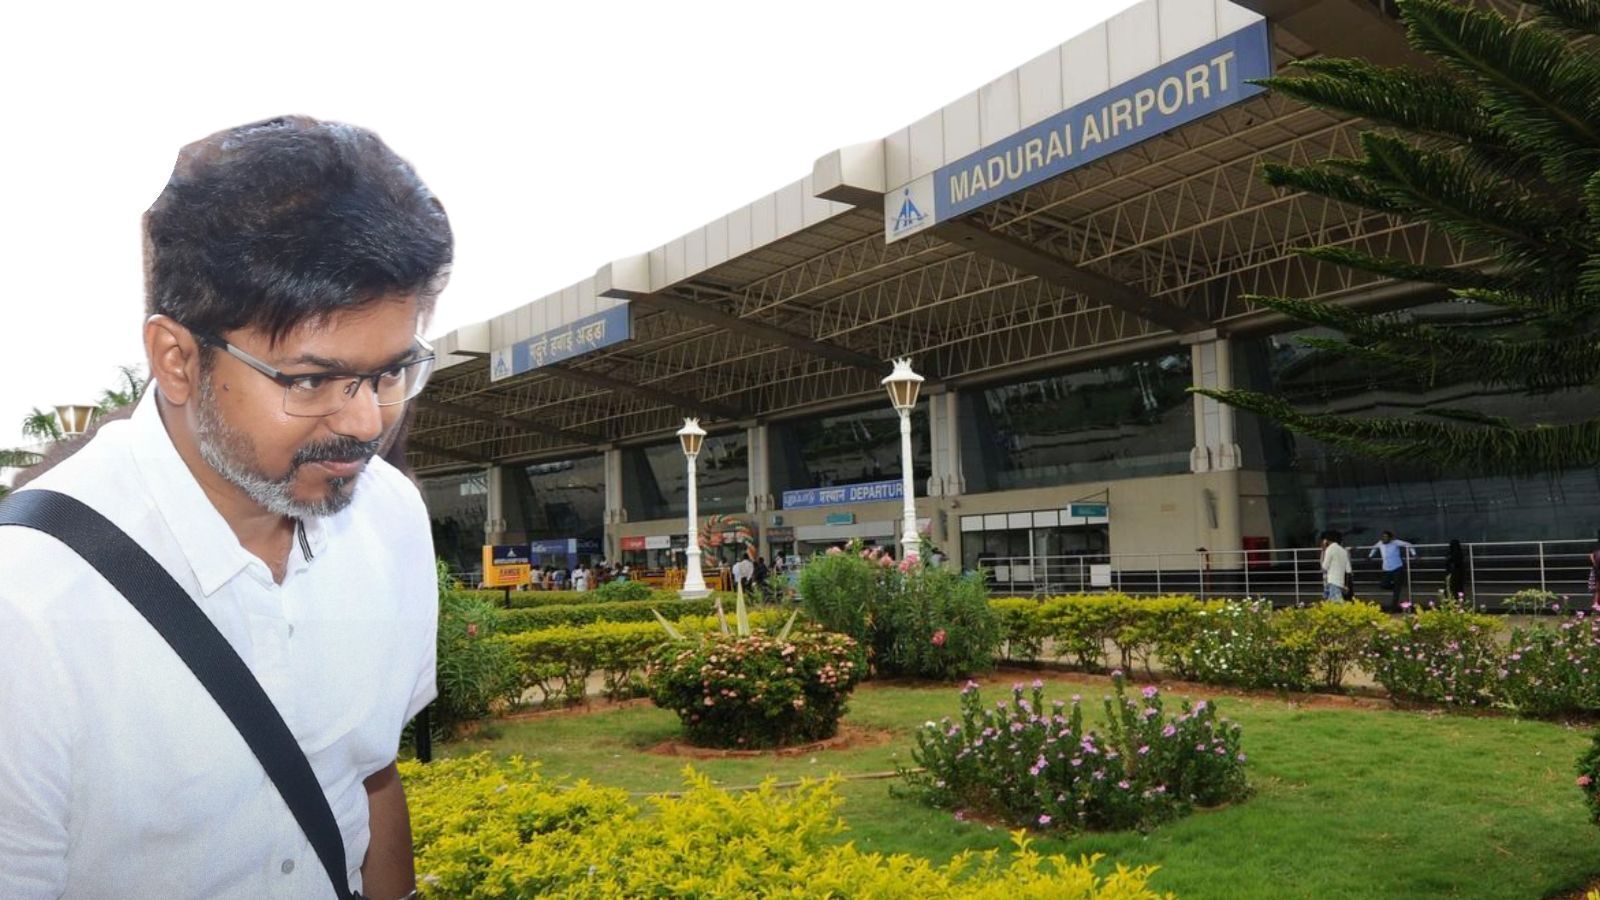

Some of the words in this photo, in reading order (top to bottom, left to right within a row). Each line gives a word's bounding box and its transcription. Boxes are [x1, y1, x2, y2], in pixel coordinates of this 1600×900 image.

[950, 123, 1073, 204] MADURAI
[1080, 51, 1235, 150] AIRPORT
[849, 482, 903, 501] DEPARTUR
